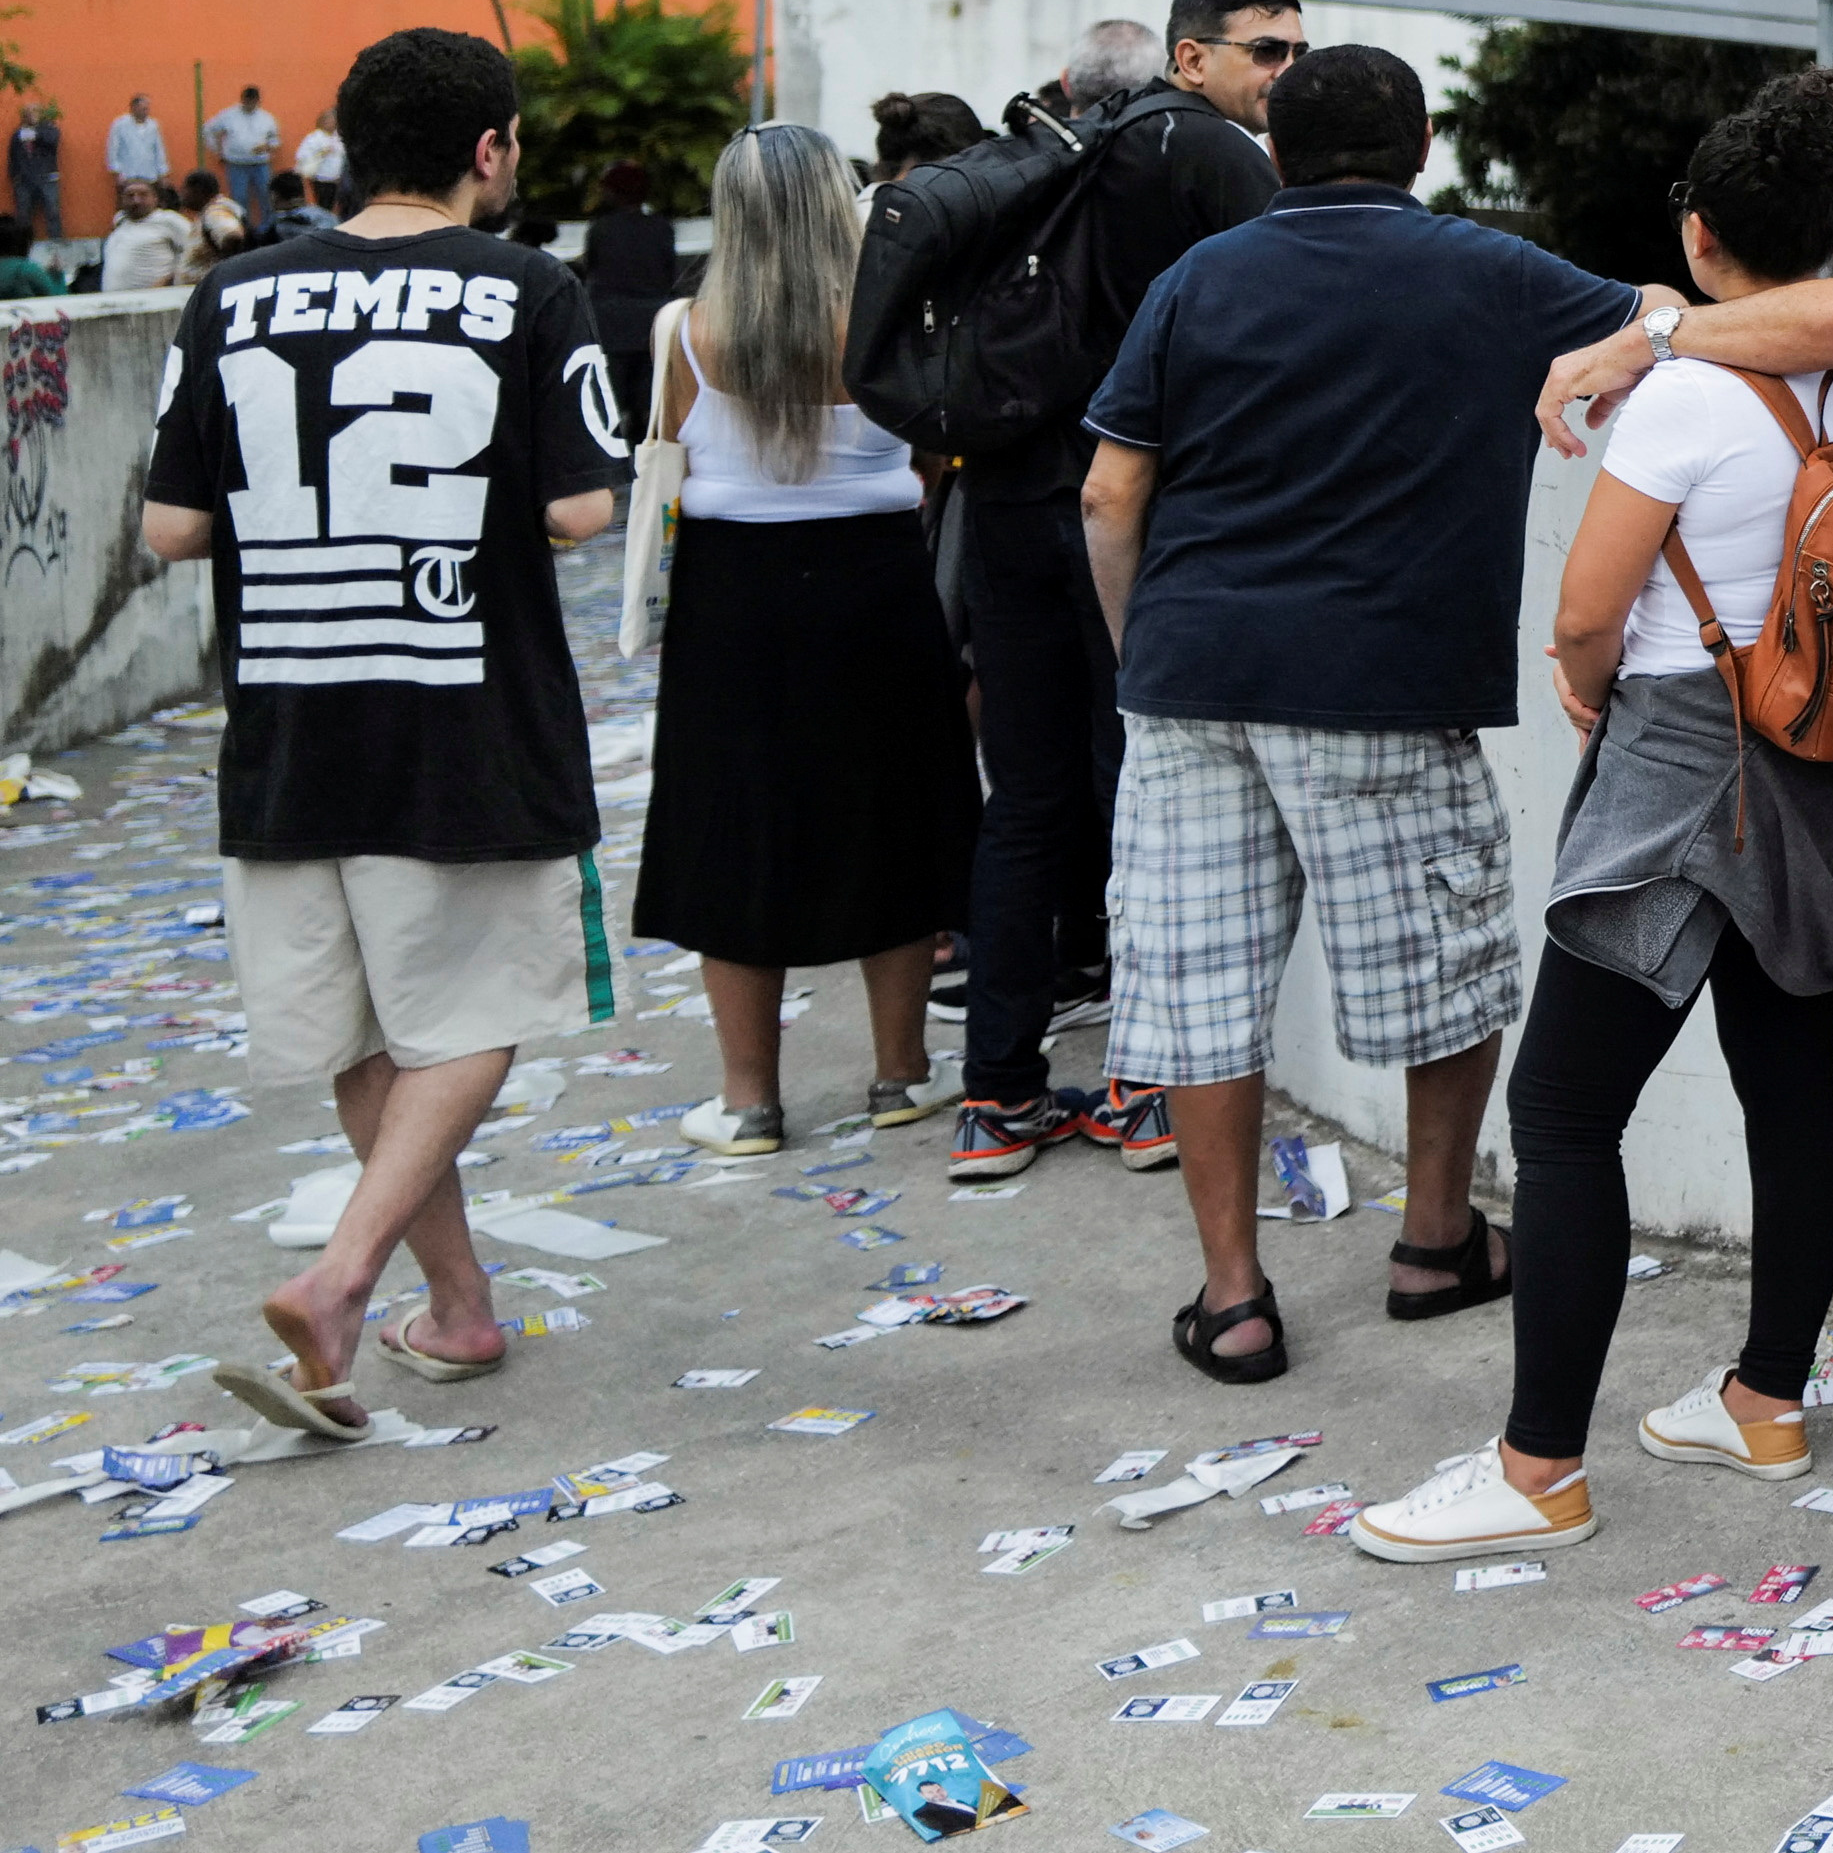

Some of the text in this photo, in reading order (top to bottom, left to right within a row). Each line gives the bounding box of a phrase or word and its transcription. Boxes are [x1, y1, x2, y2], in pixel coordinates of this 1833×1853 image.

[220, 269, 519, 345] TEMPS
[218, 340, 501, 542] 12
[890, 1753, 970, 1786] 7712
